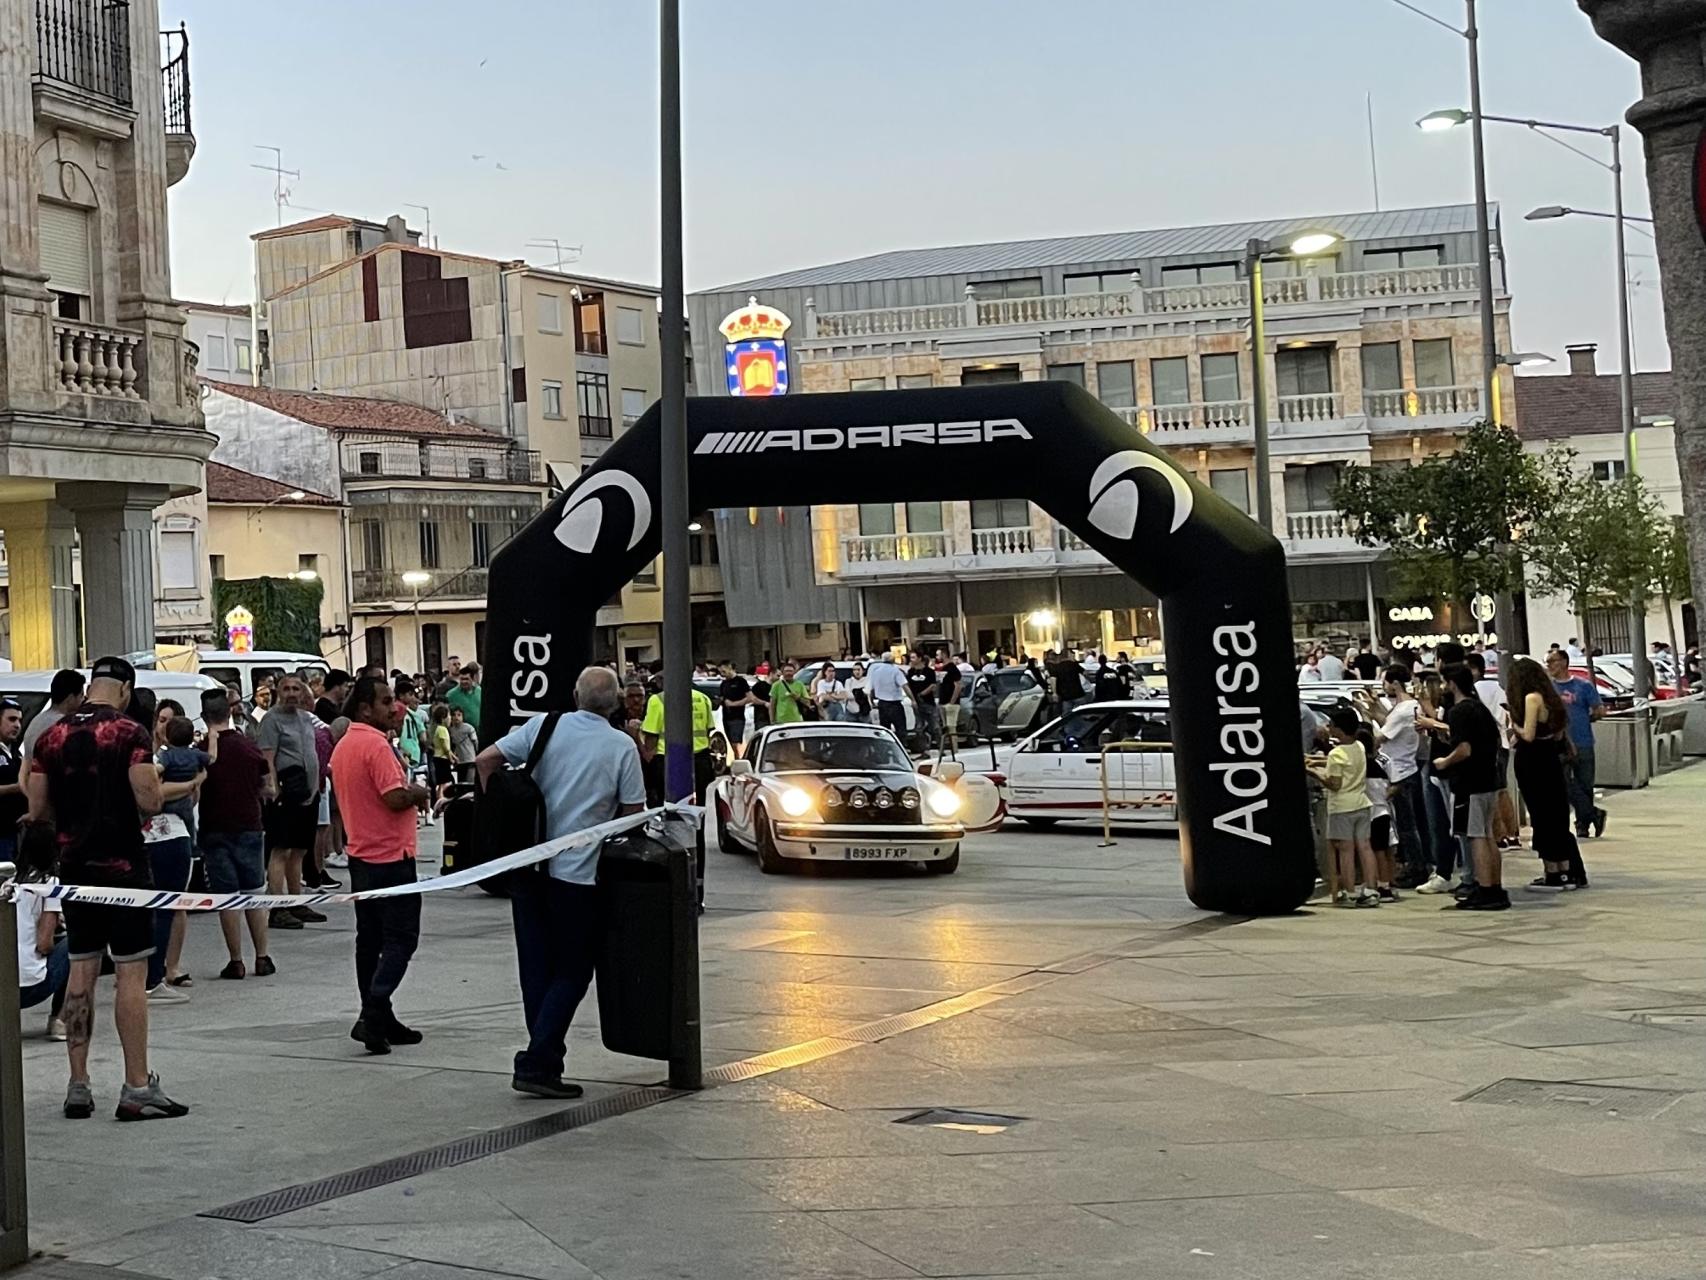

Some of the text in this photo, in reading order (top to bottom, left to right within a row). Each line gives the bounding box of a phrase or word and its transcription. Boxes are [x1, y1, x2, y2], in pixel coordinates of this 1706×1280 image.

[754, 418, 1033, 453] ADARSA
[1389, 606, 1433, 621] CASA
[508, 633, 552, 733] rsa
[1208, 620, 1272, 846] Adarsa
[852, 848, 908, 859] 8993 FXP
